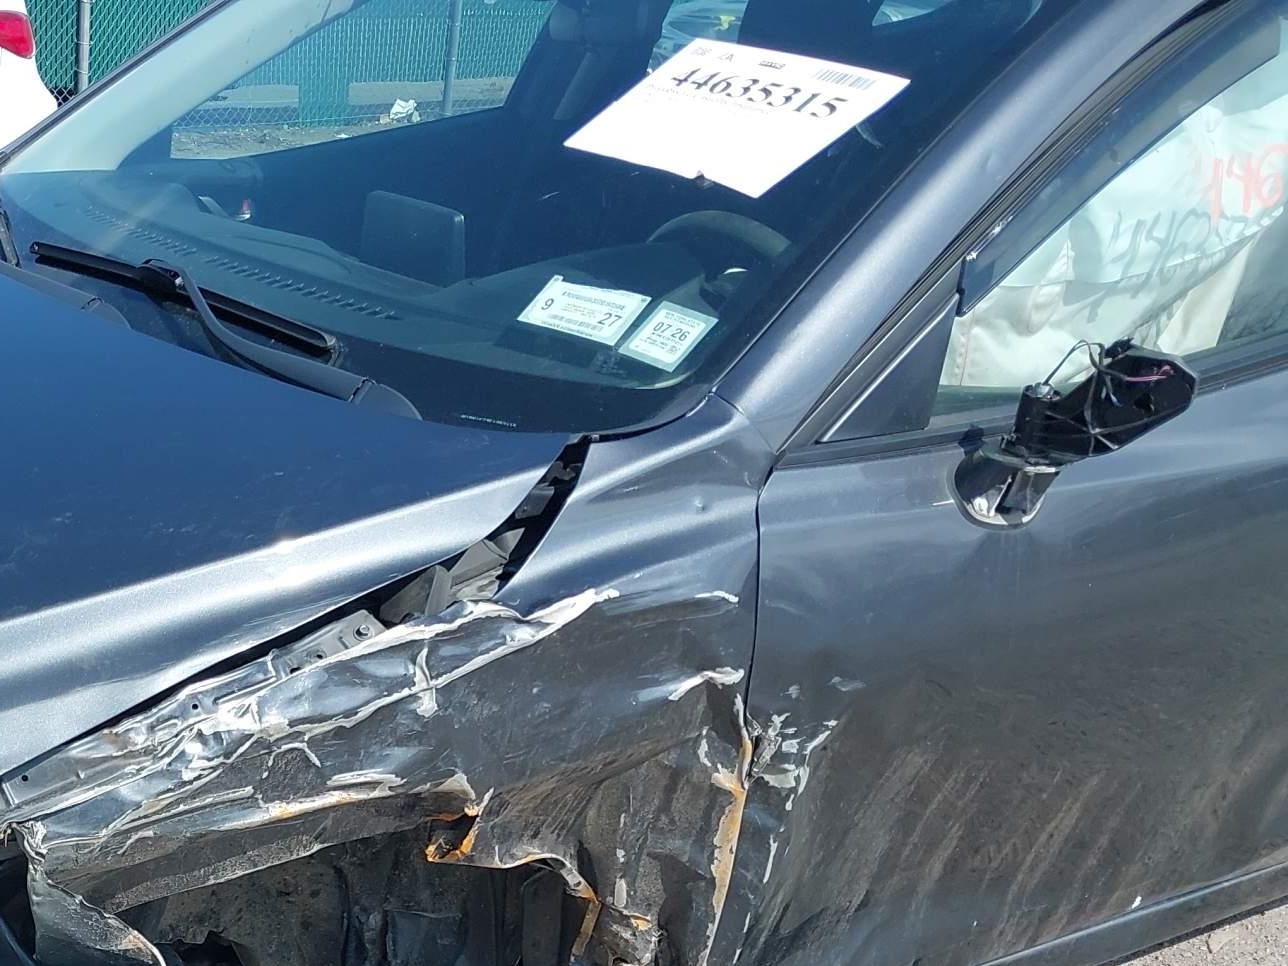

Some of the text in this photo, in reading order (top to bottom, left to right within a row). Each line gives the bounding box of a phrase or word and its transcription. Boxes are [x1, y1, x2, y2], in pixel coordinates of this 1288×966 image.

[671, 67, 849, 119] 44635315
[541, 297, 555, 312] 9
[597, 312, 624, 328] 27
[652, 321, 691, 342] 07 26
